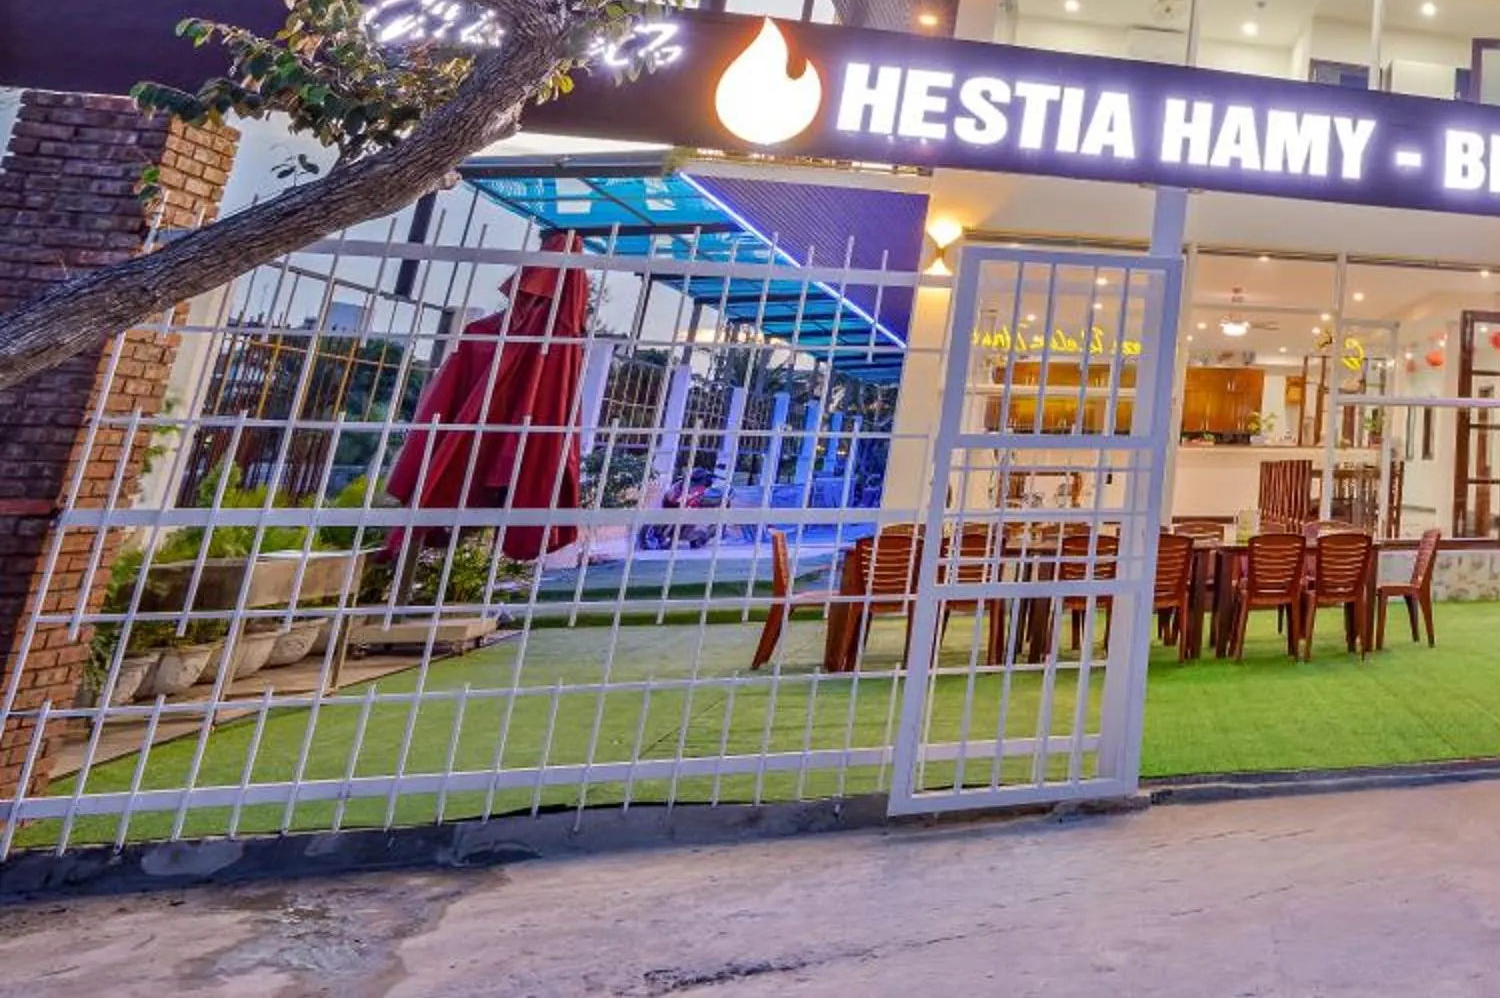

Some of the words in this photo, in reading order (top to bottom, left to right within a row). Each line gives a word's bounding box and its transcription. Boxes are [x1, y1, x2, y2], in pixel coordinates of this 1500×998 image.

[837, 62, 1136, 159] HESTIA
[1161, 98, 1376, 179] HAMY
[1396, 151, 1422, 167] -
